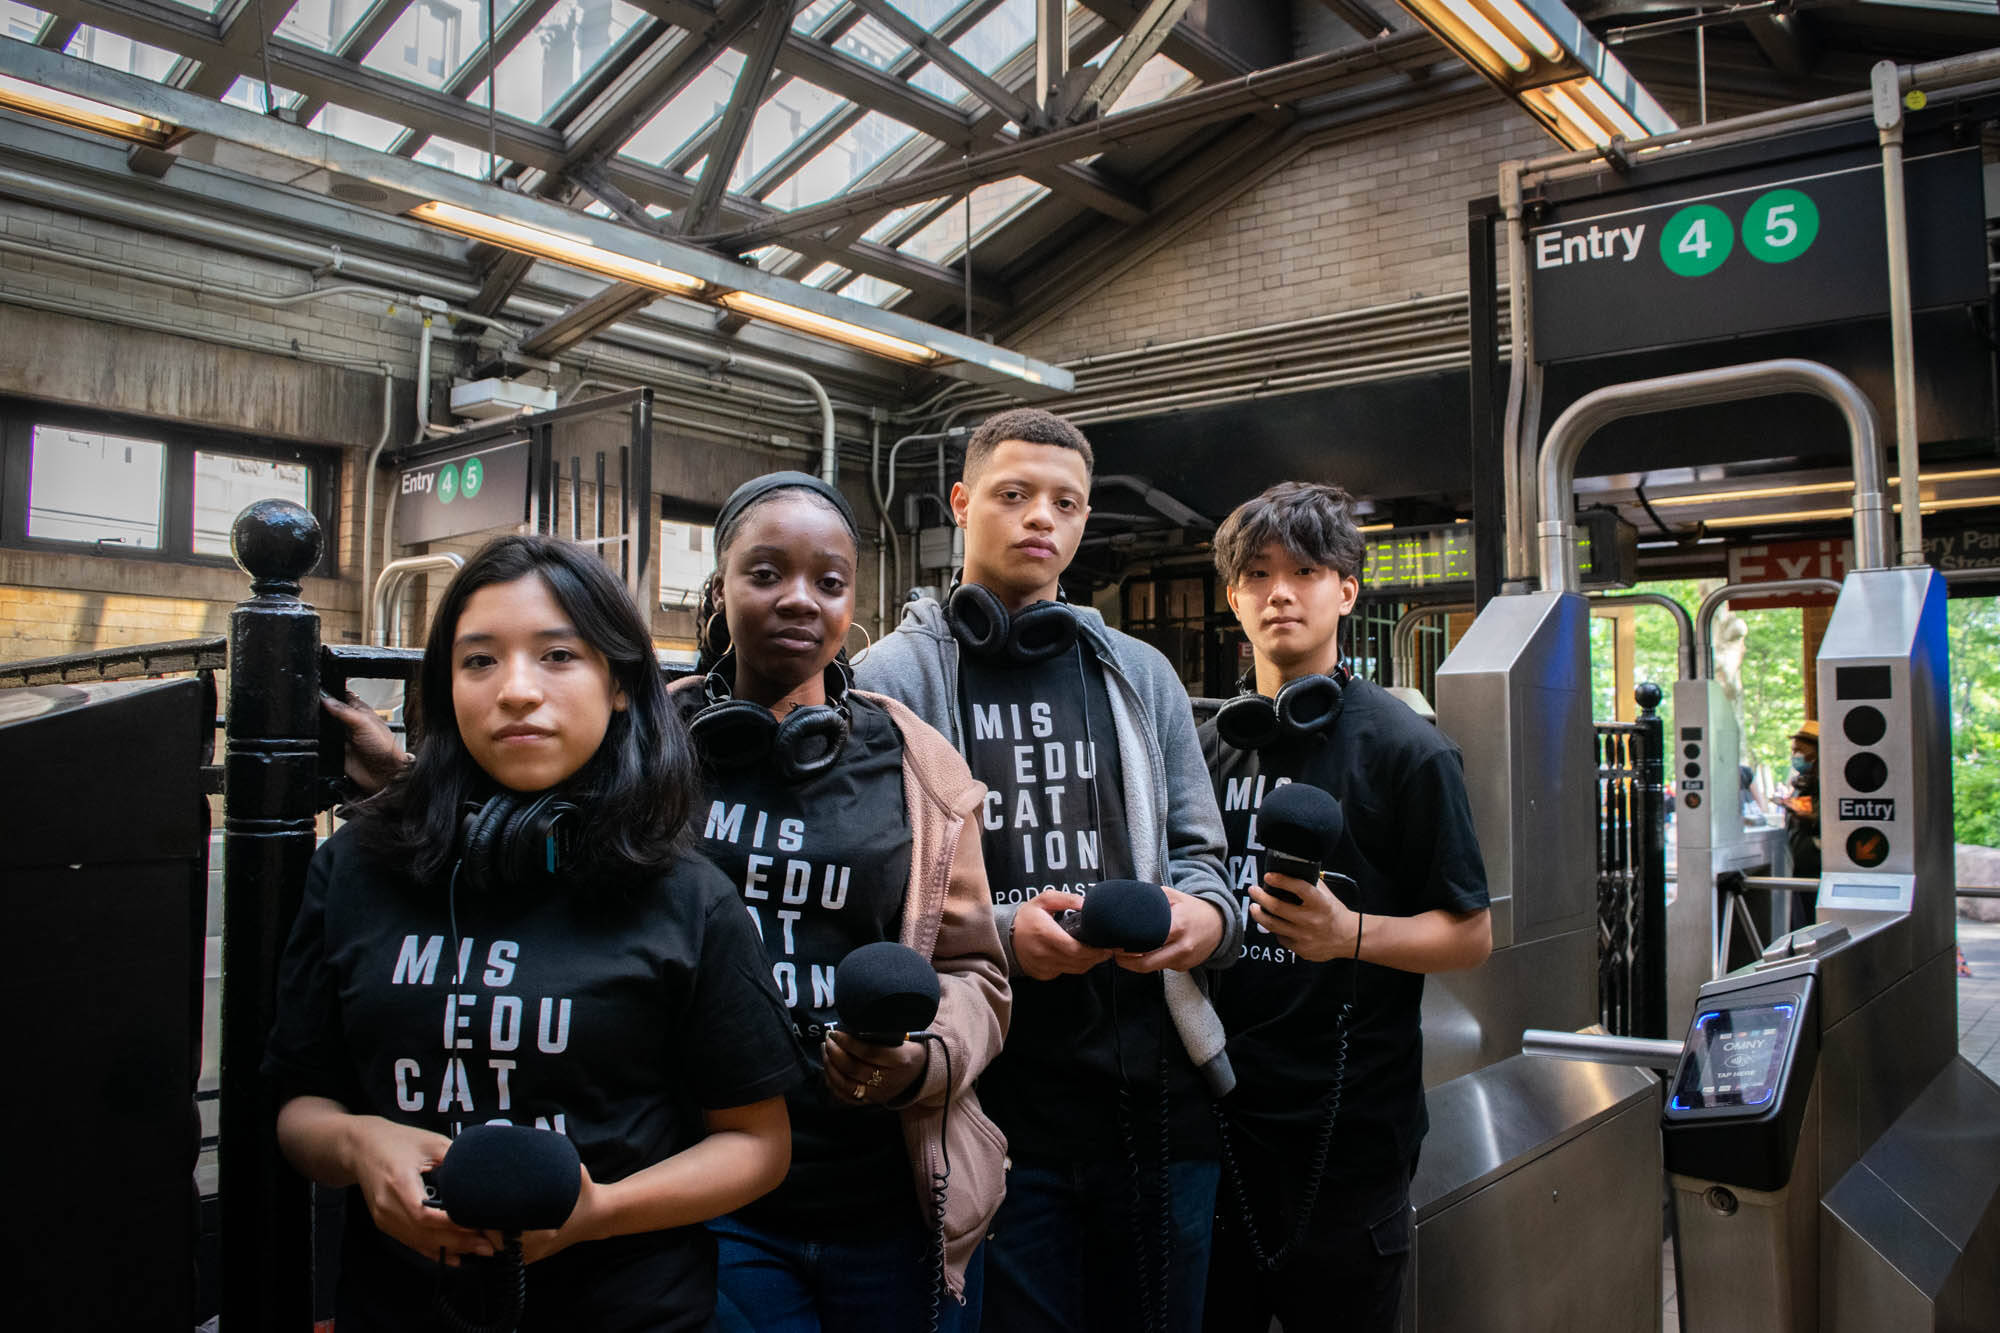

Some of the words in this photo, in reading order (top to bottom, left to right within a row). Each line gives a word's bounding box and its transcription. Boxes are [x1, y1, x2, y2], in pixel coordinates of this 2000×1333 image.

[1536, 223, 1646, 269] Entry
[1677, 219, 1712, 258] 4
[1764, 204, 1798, 247] 5
[401, 471, 435, 494] Entry
[441, 471, 452, 493] 4
[466, 465, 477, 489] 5
[1921, 537, 1955, 556] ery
[973, 702, 1053, 740] MIS
[1014, 740, 1097, 783] EDU
[982, 785, 1066, 831] CAT
[1225, 775, 1292, 811] MI
[1840, 800, 1894, 820] Entry
[704, 800, 805, 852] MIS
[1022, 830, 1099, 873] ION
[744, 854, 851, 910] EDU
[995, 882, 1097, 905] PODAS
[392, 935, 520, 987] MIS
[1238, 945, 1295, 964] DCAST
[772, 961, 836, 1009] ON
[443, 994, 573, 1054] EDU
[1723, 1039, 1767, 1052] OMNY
[394, 1058, 517, 1112] CAT
[1717, 1071, 1732, 1079] TAP
